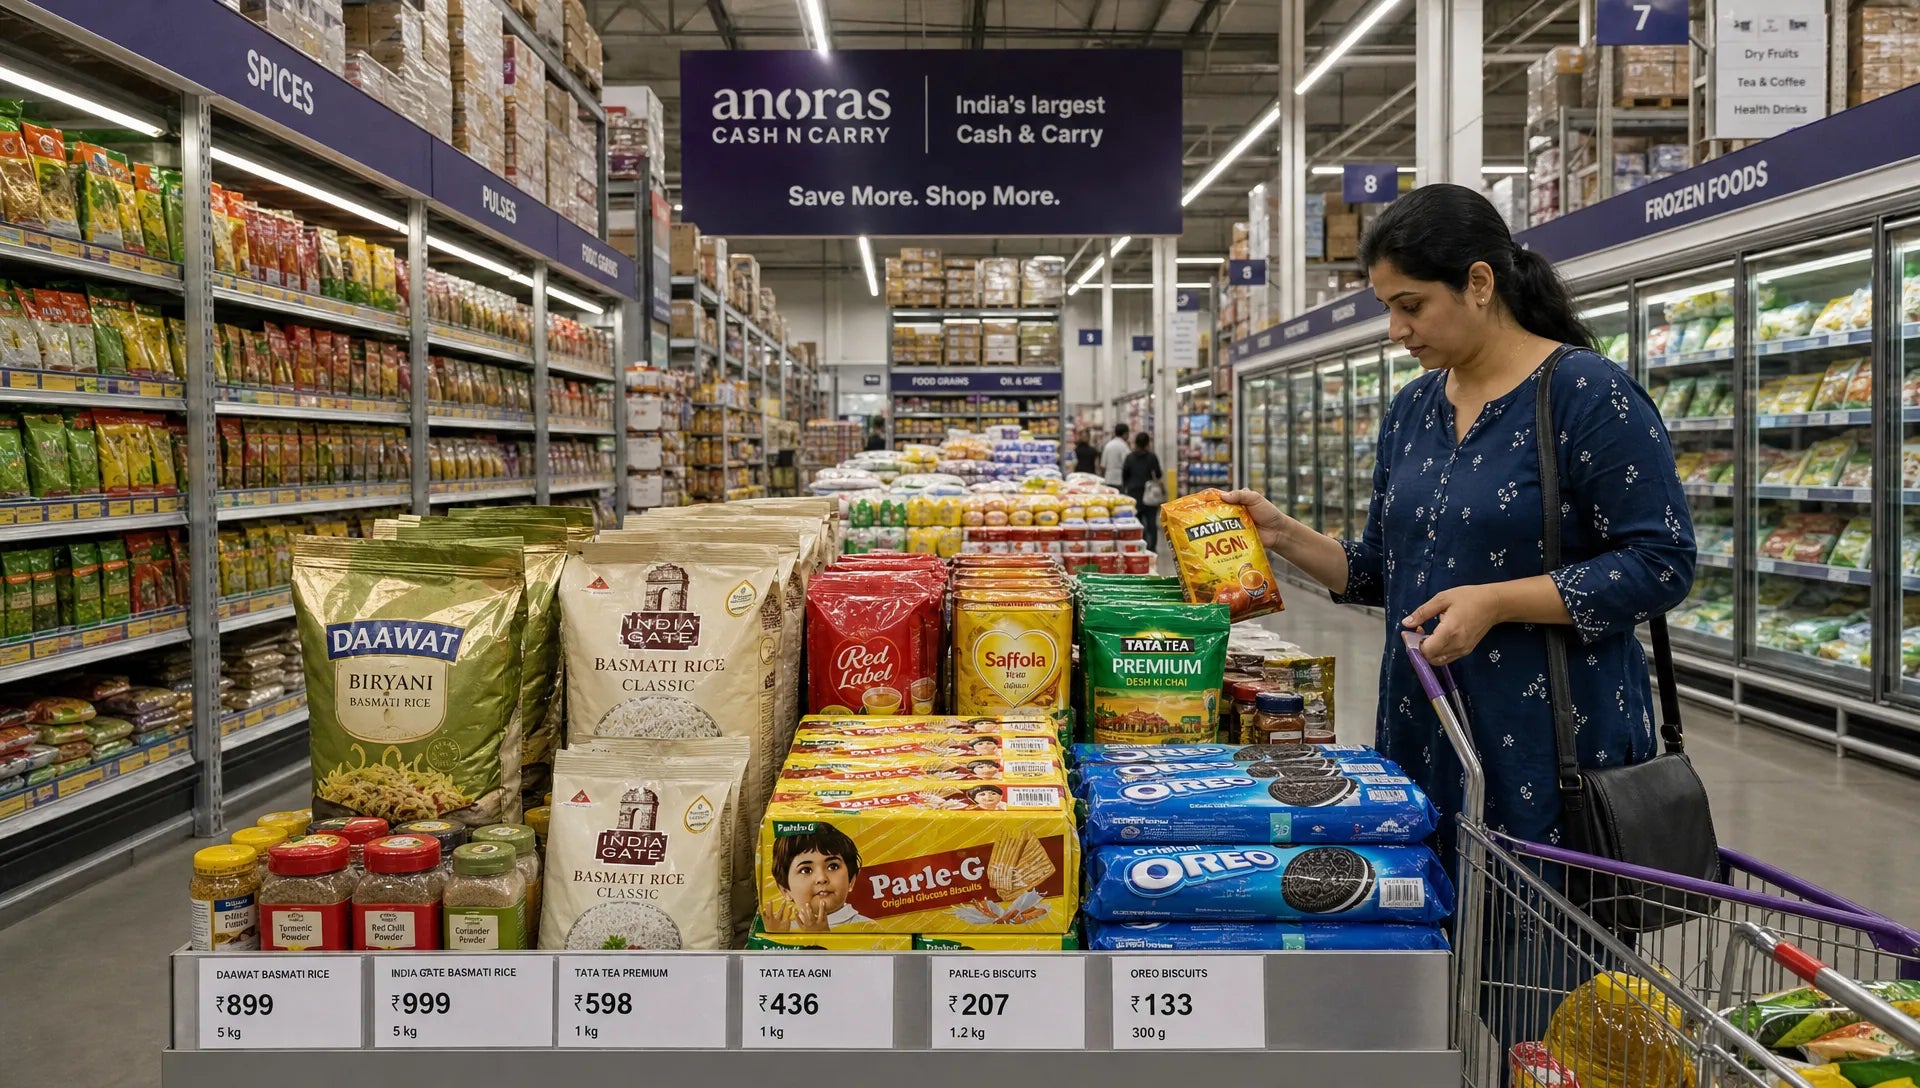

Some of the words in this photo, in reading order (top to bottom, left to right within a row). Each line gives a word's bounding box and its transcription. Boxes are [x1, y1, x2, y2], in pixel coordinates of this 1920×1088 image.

[1632, 5, 1651, 31] 7
[1745, 49, 1764, 61] Dry
[1768, 49, 1799, 60] Fruits
[247, 49, 314, 115] SPICES
[1737, 78, 1756, 87] Tea
[1759, 78, 1767, 87] &
[1770, 77, 1806, 87] Coffee
[712, 88, 892, 120] anoras
[956, 95, 1026, 114] India's
[1032, 95, 1106, 119] largest
[1734, 105, 1770, 115] Health
[1773, 105, 1807, 115] Drinks
[712, 126, 778, 144] CASH
[786, 126, 801, 144] N
[808, 126, 891, 144] CARRY
[957, 124, 1012, 144] Cash
[1018, 124, 1035, 144] &
[1042, 124, 1103, 148] Carry
[1364, 174, 1378, 193] 8
[788, 185, 845, 206] Save
[852, 185, 919, 206] More.
[925, 185, 986, 210] Shop
[993, 185, 1060, 206] More.
[1645, 182, 1705, 223] FROZEN
[1708, 160, 1769, 203] FOODS
[482, 185, 516, 224] PULSES
[912, 376, 935, 386] FOOD
[1189, 522, 1224, 538] TATA
[1224, 519, 1241, 530] TEA
[628, 618, 695, 630] INDIA
[332, 627, 459, 655] DAAWAT
[627, 632, 692, 644] GATE
[1125, 639, 1160, 651] TATA
[1164, 640, 1189, 652] TEA
[838, 645, 889, 671] Red
[985, 651, 1046, 671] Saffola
[594, 657, 676, 673] BASMATI
[684, 657, 725, 673] RICE
[1112, 658, 1201, 675] PREMIUM
[349, 674, 432, 690] BIRYANI
[838, 663, 893, 690] Label
[1126, 678, 1150, 687] DESH
[1153, 678, 1163, 687] KI
[1165, 678, 1187, 687] CHAI
[622, 679, 695, 692] CLASSIC
[350, 697, 400, 707] BASMATI
[404, 698, 431, 708] RICE
[1124, 777, 1254, 800] OREO
[602, 835, 663, 848] INDIA
[602, 848, 661, 860] GATE
[1131, 851, 1275, 890] OREO
[573, 870, 644, 885] BASMATI
[650, 873, 685, 885] RICE
[869, 856, 985, 899] Parle-G
[596, 887, 659, 900] CLASSIC
[372, 923, 386, 931] Red
[281, 933, 310, 941] Powder
[375, 933, 403, 941] Powder
[216, 970, 259, 979] DAAWAT
[262, 970, 305, 979] BASMATI
[308, 969, 329, 979] RICE
[391, 968, 418, 978] INDIA
[420, 968, 445, 977] GATE
[448, 968, 491, 977] BASMATI
[495, 967, 516, 977] RICE
[575, 968, 600, 978] TATA
[602, 968, 620, 978] TEA
[623, 968, 668, 978] PREMIUM
[760, 969, 785, 978] TATA
[787, 969, 806, 978] TEA
[808, 969, 832, 978] AGNI
[949, 969, 990, 978] PARLE-G
[993, 969, 1037, 978] BISCUITS
[1131, 969, 1159, 978] OREO
[1162, 969, 1208, 978] BISCUITS
[216, 993, 274, 1016] ₹899
[391, 992, 451, 1015] ₹999
[574, 992, 633, 1015] ₹598
[759, 992, 819, 1015] ₹436
[217, 1027, 224, 1037] 5
[228, 1027, 241, 1040] kg
[393, 1026, 400, 1036] 5
[403, 1026, 417, 1039] kg
[575, 1026, 580, 1036] 1
[585, 1026, 598, 1039] kg
[760, 1026, 766, 1037] 1
[770, 1026, 784, 1039] kg
[950, 1027, 968, 1038] 1.2
[971, 1027, 985, 1040] kg
[1132, 1027, 1155, 1038] 300
[1158, 1029, 1166, 1041] g
